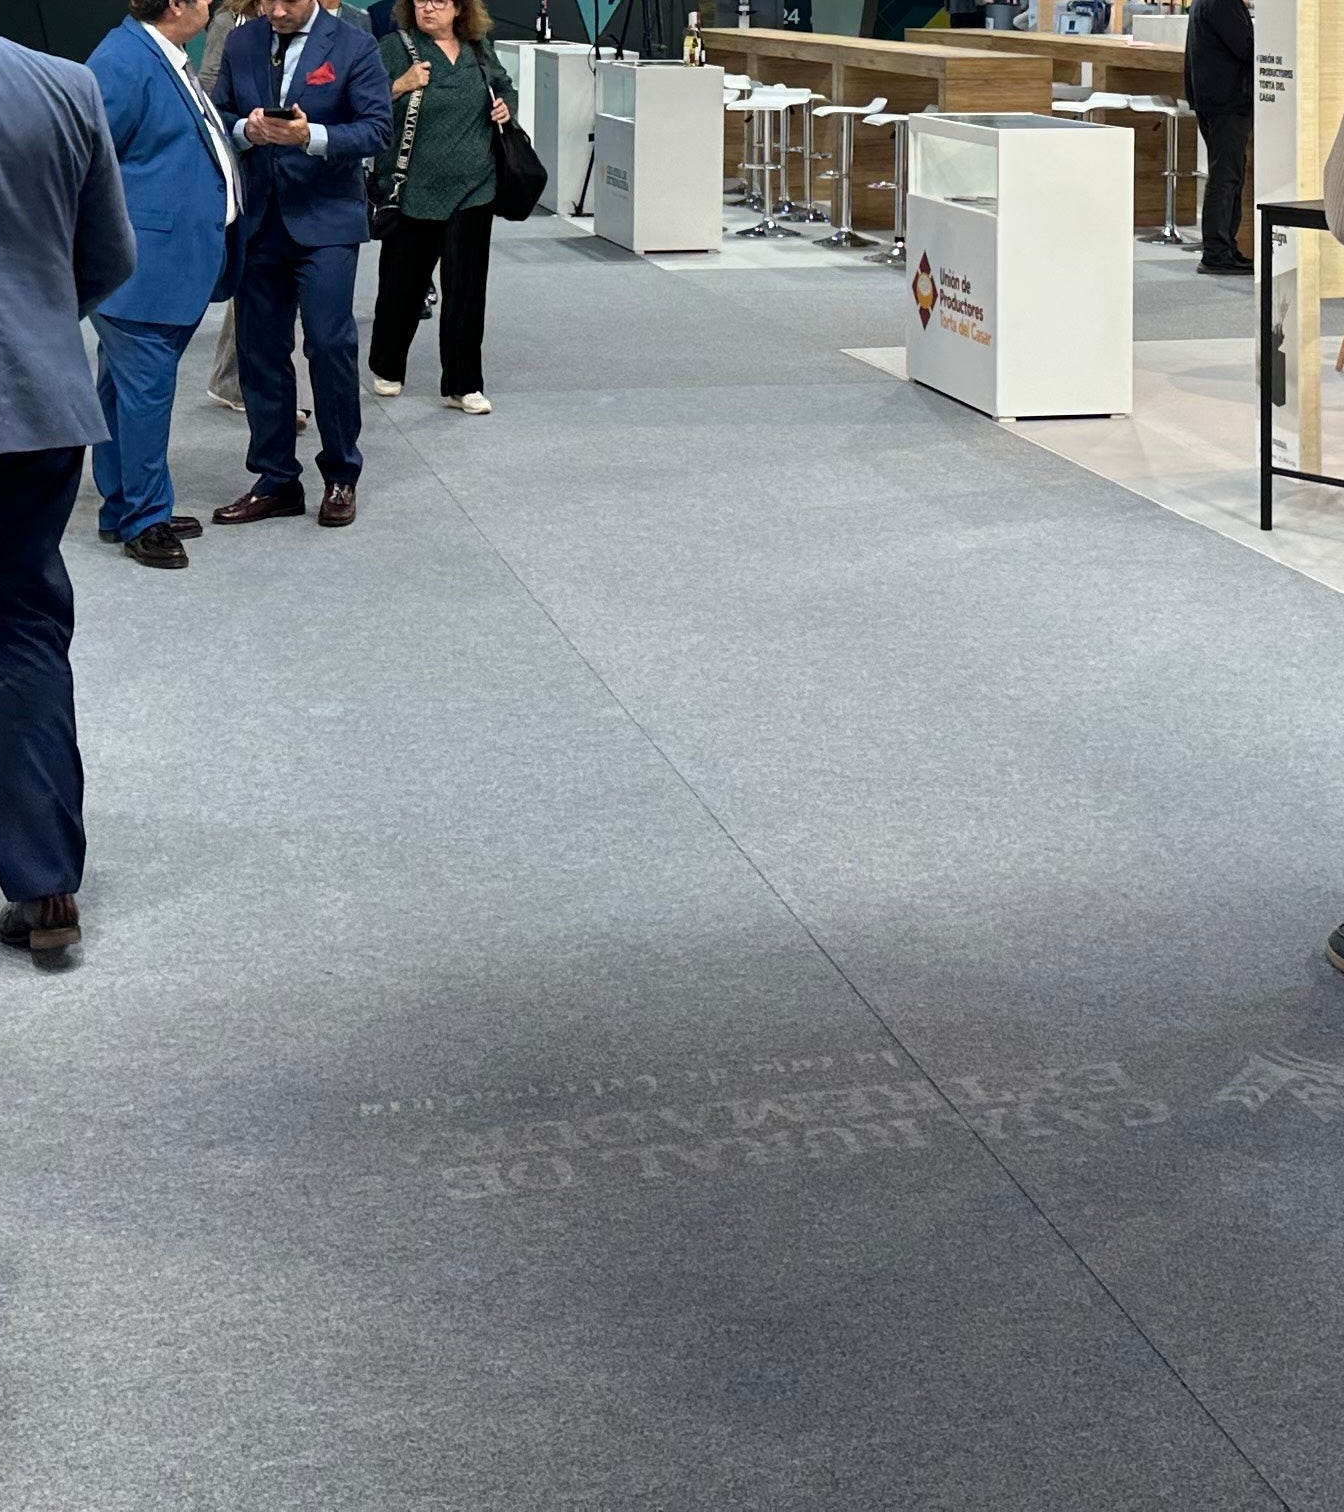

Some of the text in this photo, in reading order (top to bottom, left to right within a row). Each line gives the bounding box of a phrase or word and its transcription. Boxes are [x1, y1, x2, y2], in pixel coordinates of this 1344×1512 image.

[939, 267, 971, 295] Unión de
[939, 288, 984, 322] Productores
